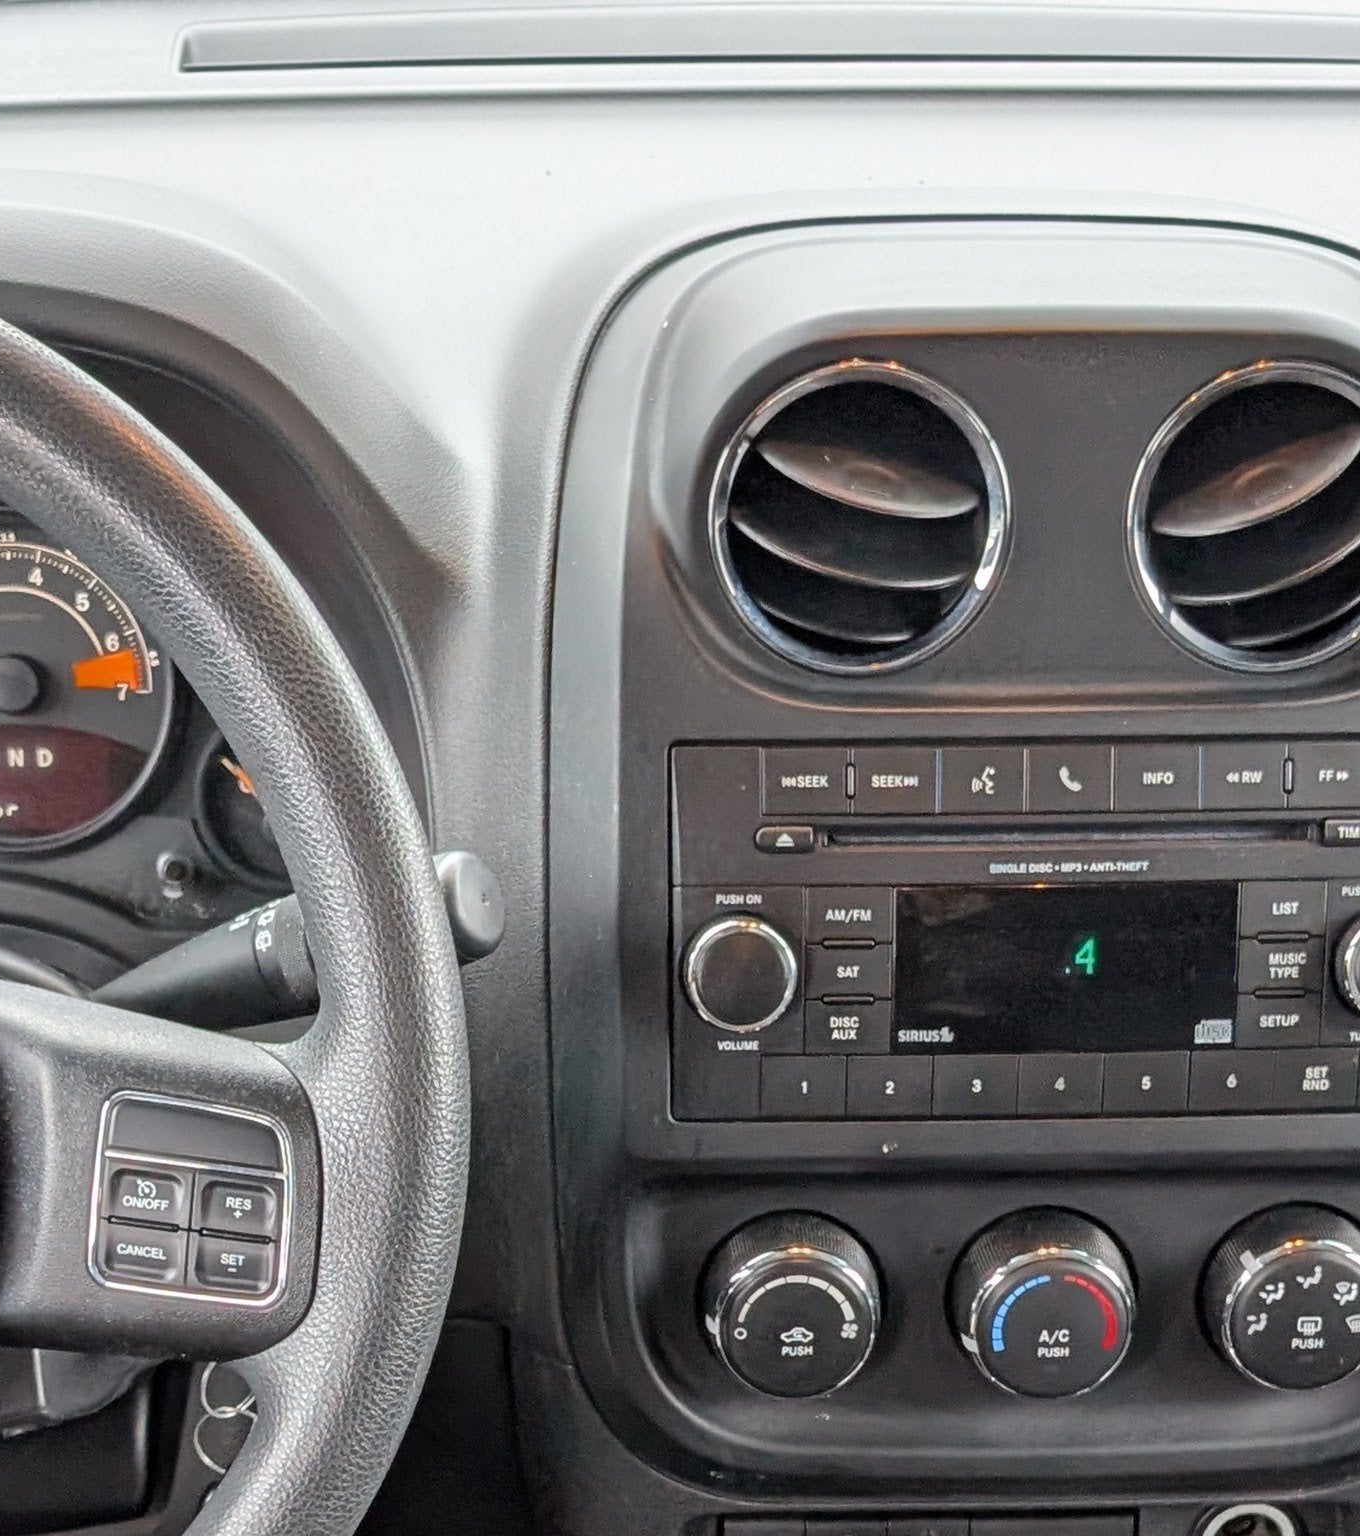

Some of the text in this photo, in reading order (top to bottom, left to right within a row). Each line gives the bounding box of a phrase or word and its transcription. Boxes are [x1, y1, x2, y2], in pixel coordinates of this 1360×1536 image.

[28, 567, 44, 586] 4
[74, 590, 91, 613] 5
[103, 632, 120, 653] 6
[115, 683, 129, 702] 7
[7, 749, 24, 768] N
[36, 748, 55, 768] D
[796, 775, 829, 789] SEEK
[871, 774, 904, 789] SEEK
[1142, 772, 1175, 786] INFO
[1242, 771, 1262, 784] RW
[1318, 769, 1335, 782] FF
[990, 863, 1027, 874] SINGLE
[1028, 863, 1053, 873] DISC
[1089, 859, 1150, 872] ANTI-THEFT
[716, 893, 762, 905] PUSH ON
[825, 908, 872, 922] AM/FM
[1272, 901, 1300, 916] LIST
[1074, 937, 1098, 977] 4
[1268, 951, 1307, 967] MUSIC
[836, 965, 860, 979] SAT
[1269, 966, 1300, 980] TYPE
[829, 1015, 860, 1029] DISC
[1259, 1014, 1300, 1028] SETUP
[830, 1028, 858, 1041] AUX
[897, 1028, 940, 1043] SIRIUS
[717, 1039, 760, 1052] VOLUME
[1305, 1065, 1329, 1080] SET
[800, 1080, 809, 1094] 1
[884, 1080, 895, 1094] 2
[971, 1079, 982, 1093] 3
[1054, 1076, 1066, 1091] 4
[1141, 1075, 1152, 1089] 5
[1226, 1073, 1238, 1089] 6
[1302, 1079, 1330, 1092] RND
[122, 1195, 170, 1212] ON/OFF
[225, 1196, 253, 1211] RES
[116, 1243, 167, 1261] CANCEL
[220, 1253, 245, 1267] SET
[1038, 1328, 1070, 1345] A/C
[1291, 1337, 1325, 1350] PUSH
[781, 1346, 814, 1357] PUSH
[1037, 1346, 1070, 1359] PUSH
